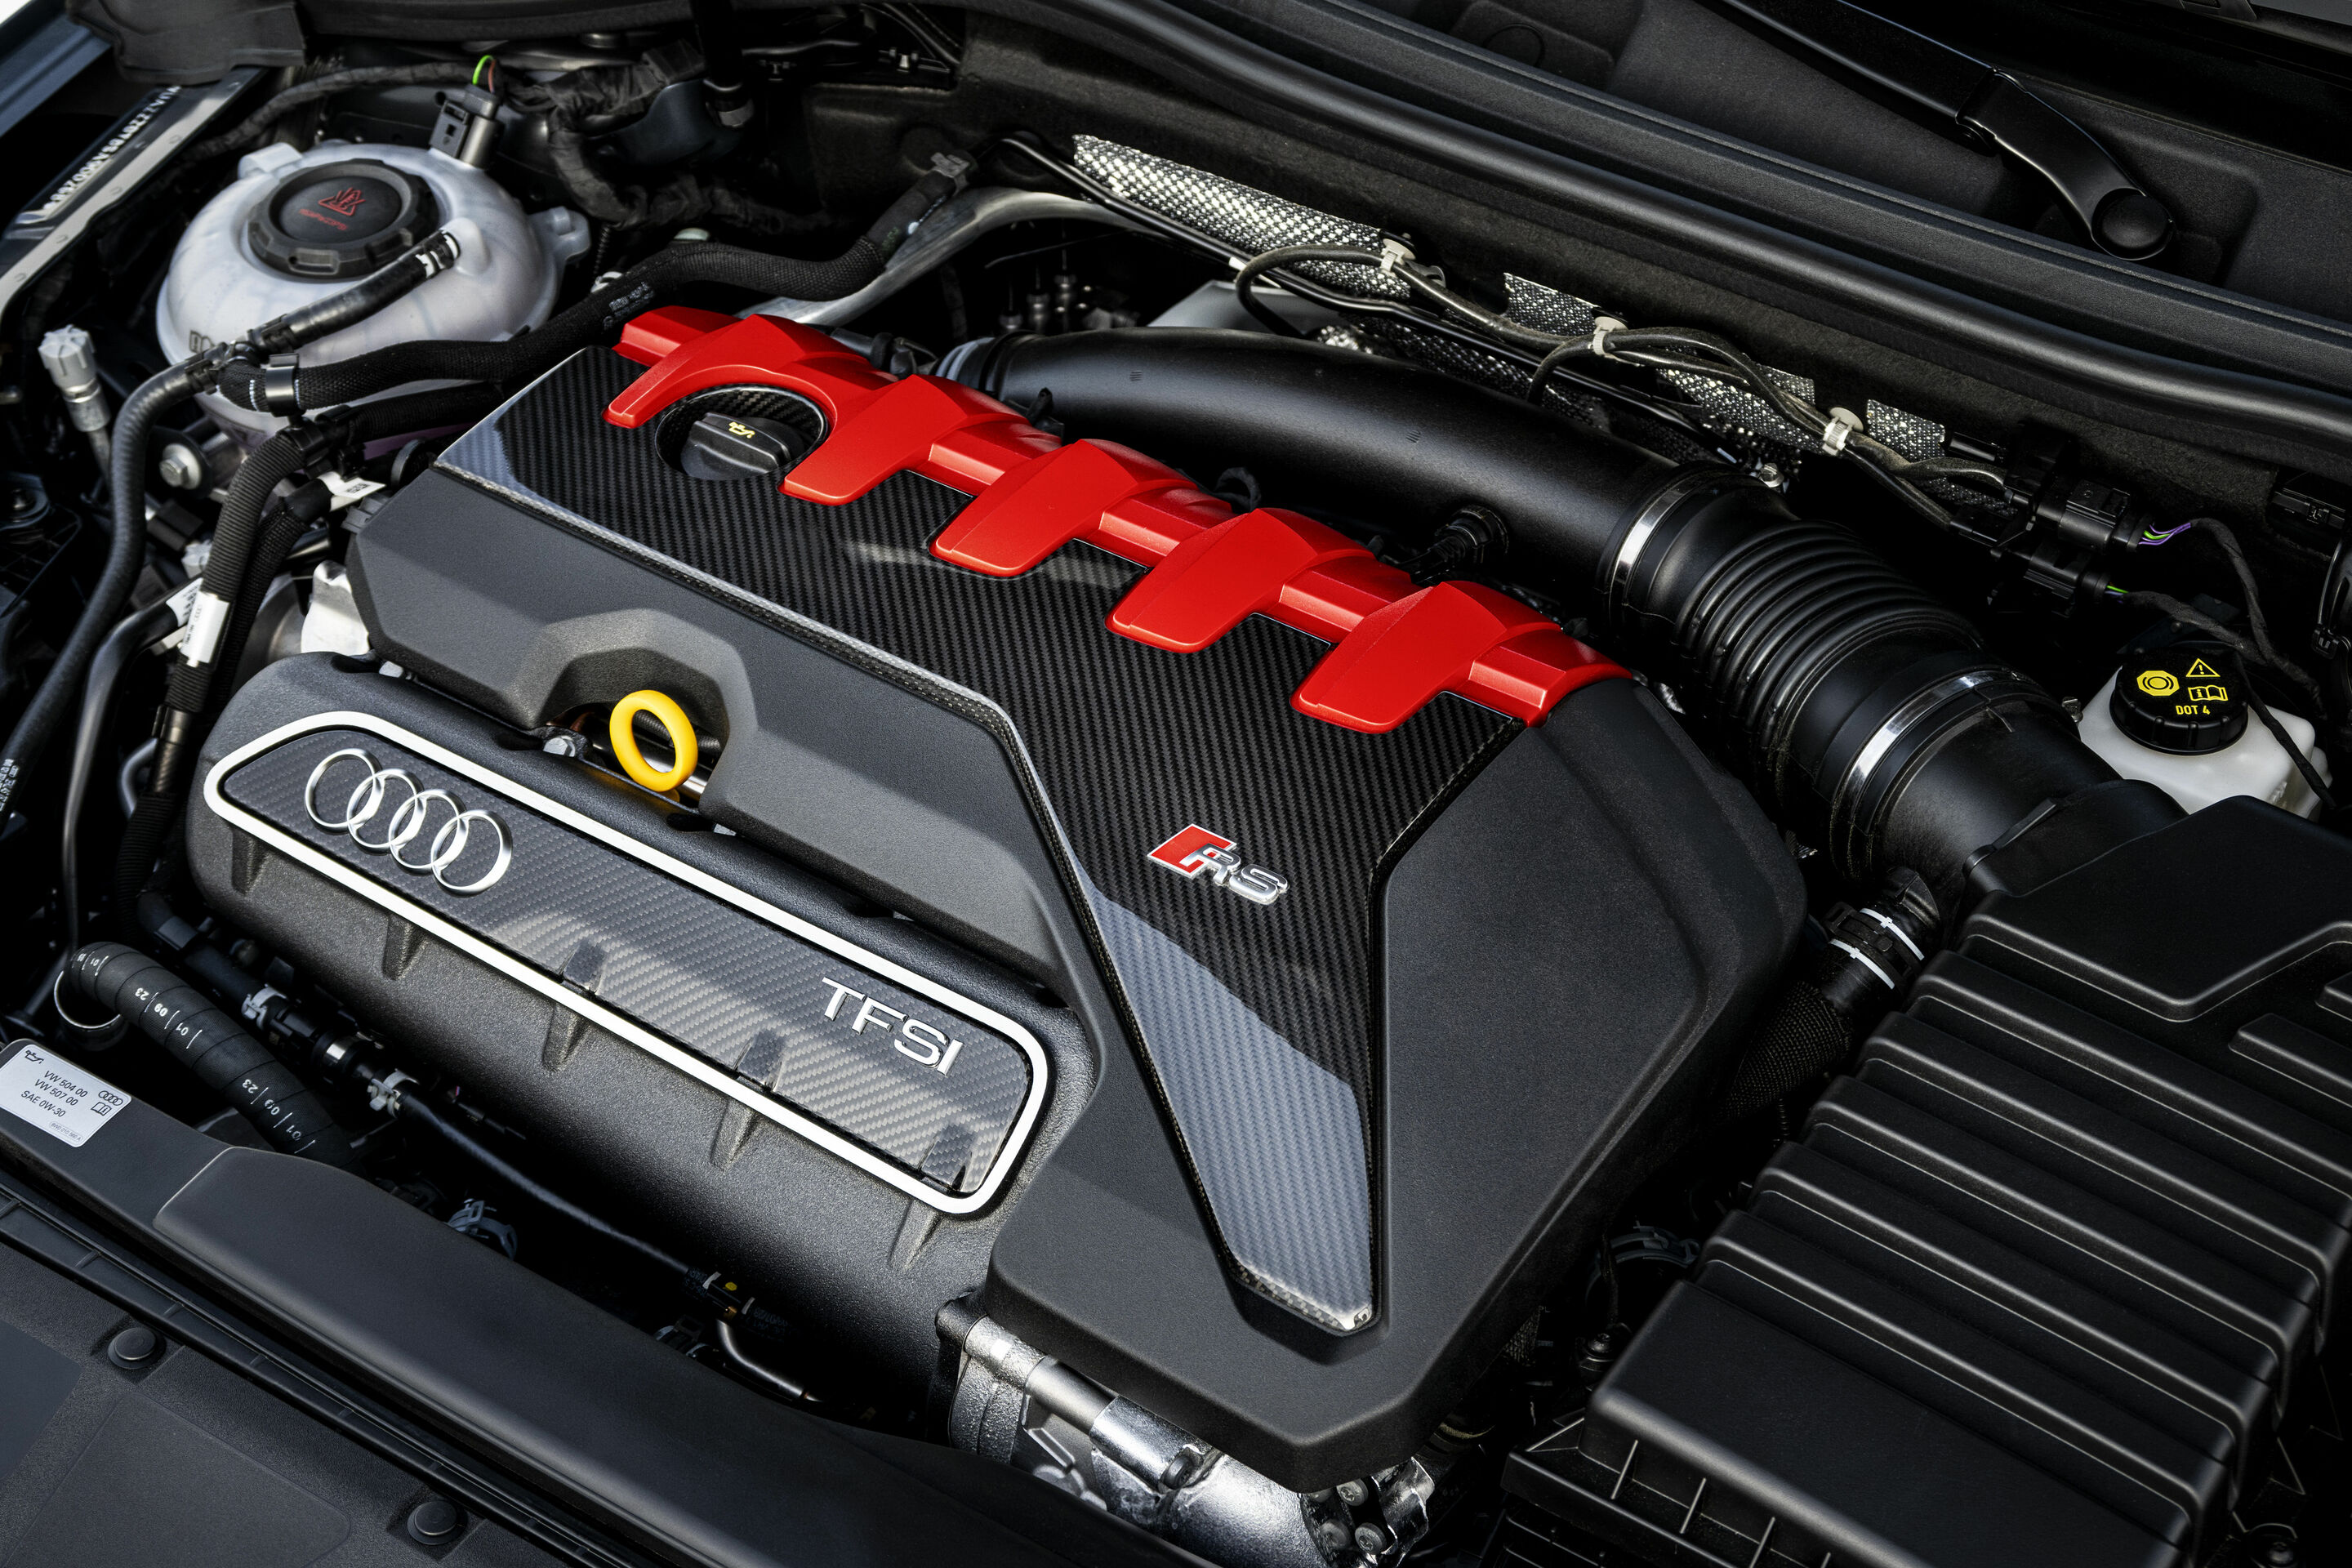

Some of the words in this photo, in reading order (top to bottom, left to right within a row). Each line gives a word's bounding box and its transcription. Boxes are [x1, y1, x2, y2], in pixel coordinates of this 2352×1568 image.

[2176, 705, 2198, 715] DOT
[2202, 705, 2211, 715] 4
[1176, 841, 1290, 905] RS
[135, 987, 149, 1001] 23
[154, 1003, 168, 1017] 09
[176, 1022, 189, 1036] 01
[822, 977, 964, 1076] TFSI
[34, 1079, 51, 1091] VW
[50, 1088, 68, 1099] 507
[65, 1096, 78, 1106] 00
[44, 1071, 61, 1083] VW
[60, 1079, 77, 1091] 504
[75, 1088, 88, 1098] 00
[242, 1079, 259, 1094] 23
[21, 1090, 41, 1104] SAE
[38, 1100, 66, 1117] 0W-30
[286, 1125, 301, 1141] 01
